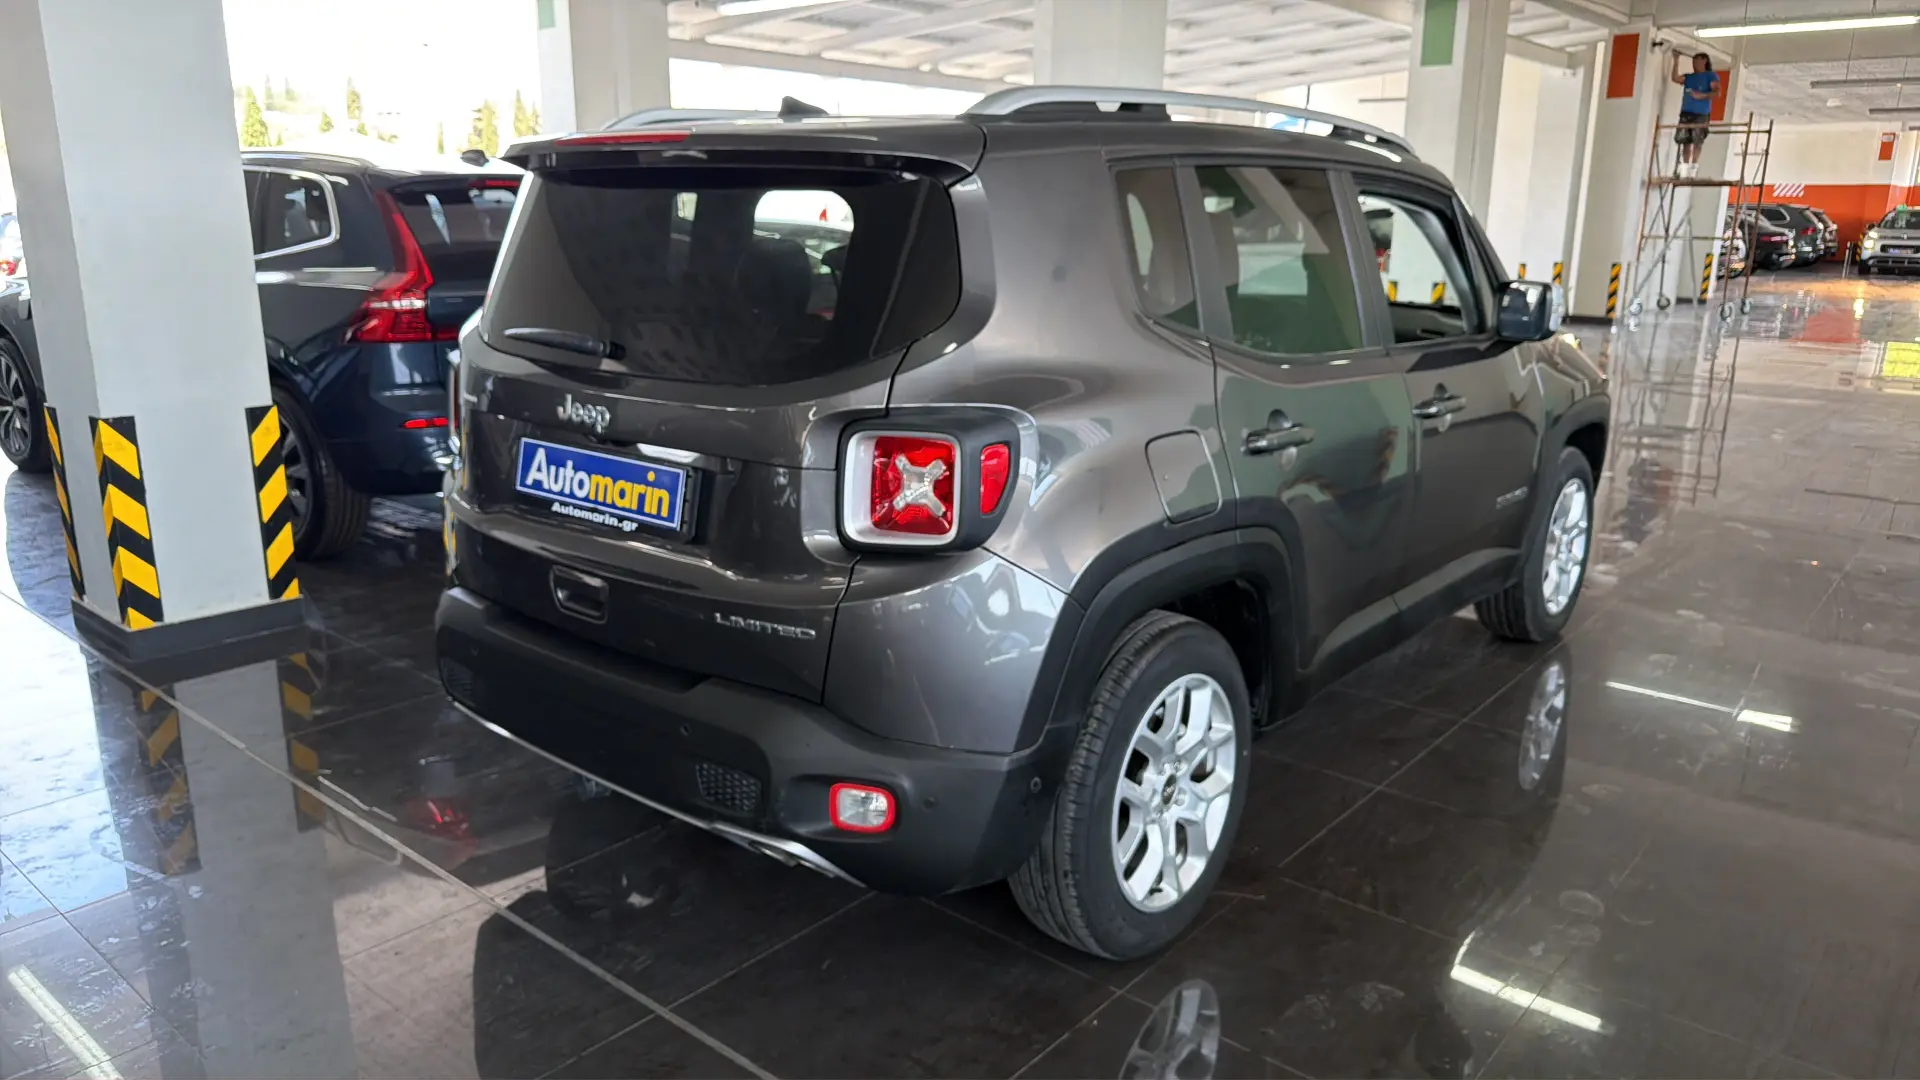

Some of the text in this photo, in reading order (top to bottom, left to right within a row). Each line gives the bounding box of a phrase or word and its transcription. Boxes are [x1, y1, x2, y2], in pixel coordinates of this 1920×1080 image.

[556, 393, 611, 434] Jeep
[525, 447, 670, 518] Automarin
[551, 501, 639, 532] Automarin.gr
[714, 612, 817, 640] LIMITED
